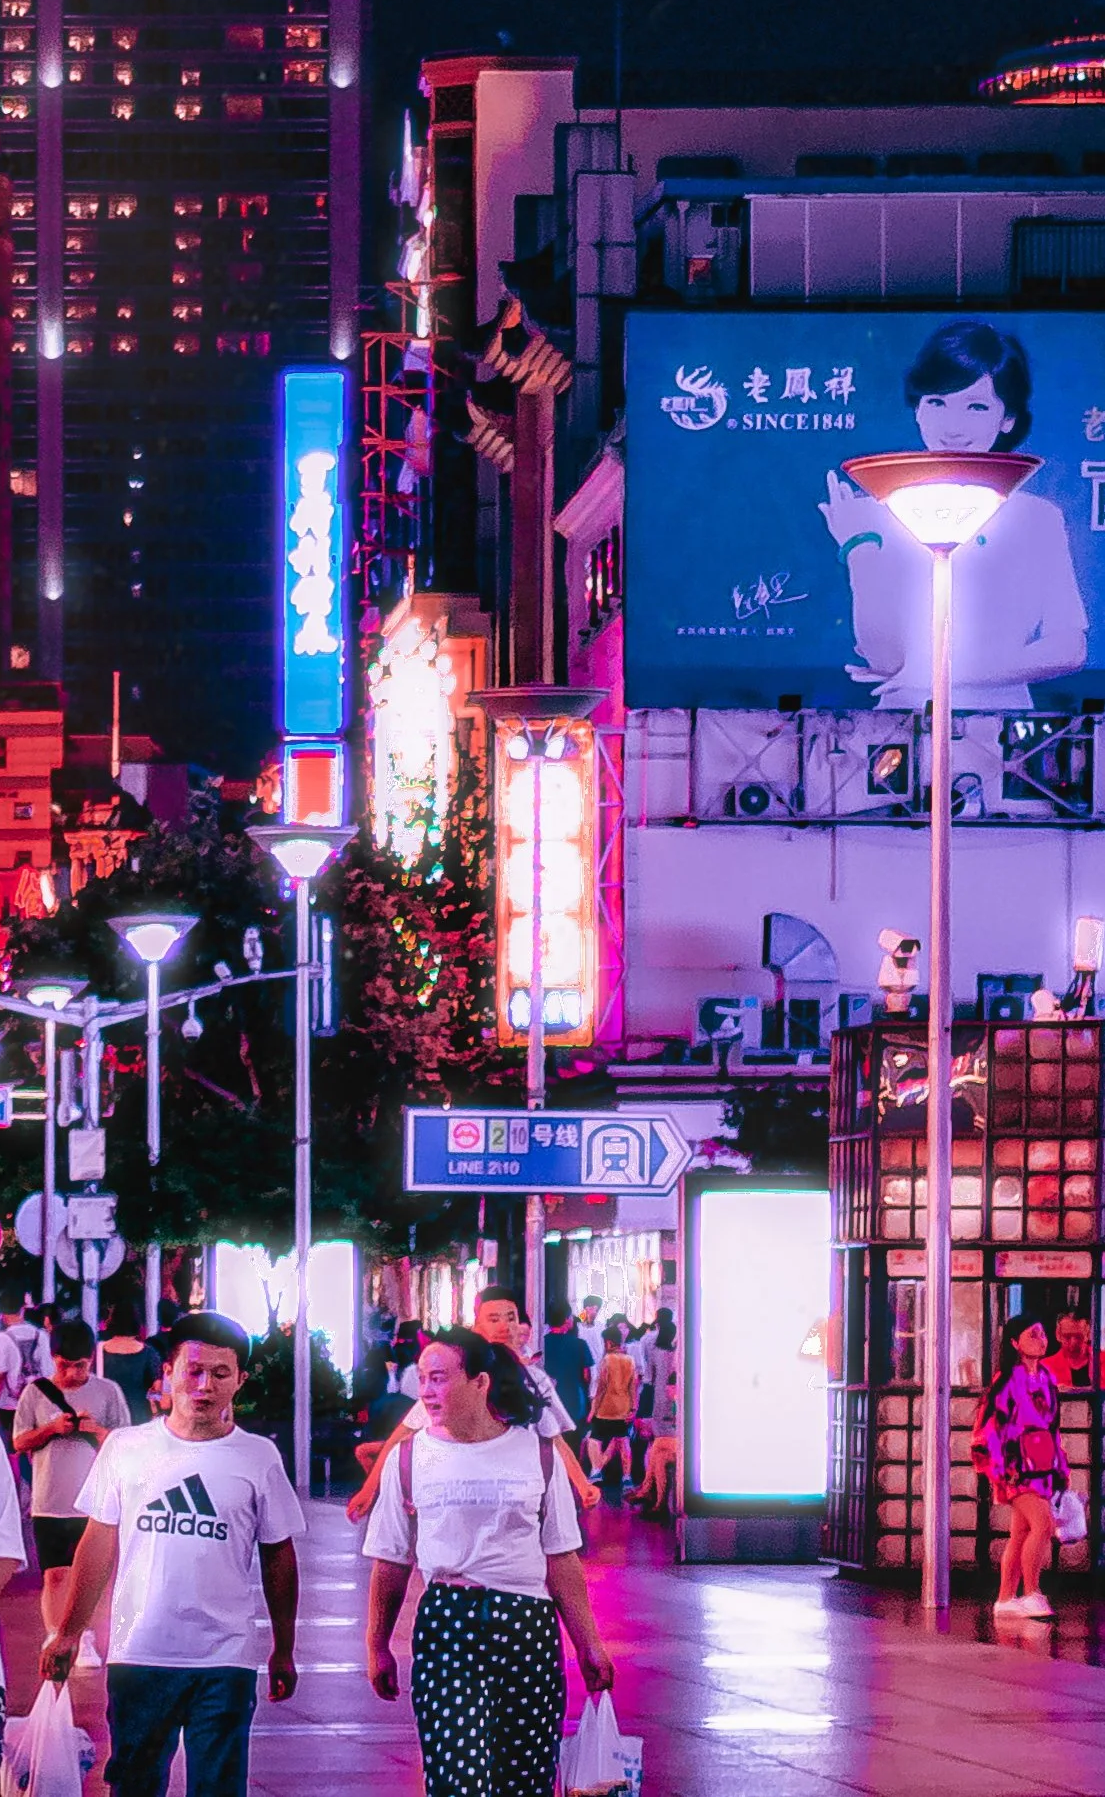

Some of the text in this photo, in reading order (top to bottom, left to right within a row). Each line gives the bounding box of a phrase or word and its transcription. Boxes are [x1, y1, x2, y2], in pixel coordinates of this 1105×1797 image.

[492, 1123, 579, 1149] 2 10 号线
[448, 1160, 485, 1175] LINE
[136, 1510, 228, 1541] adidas
